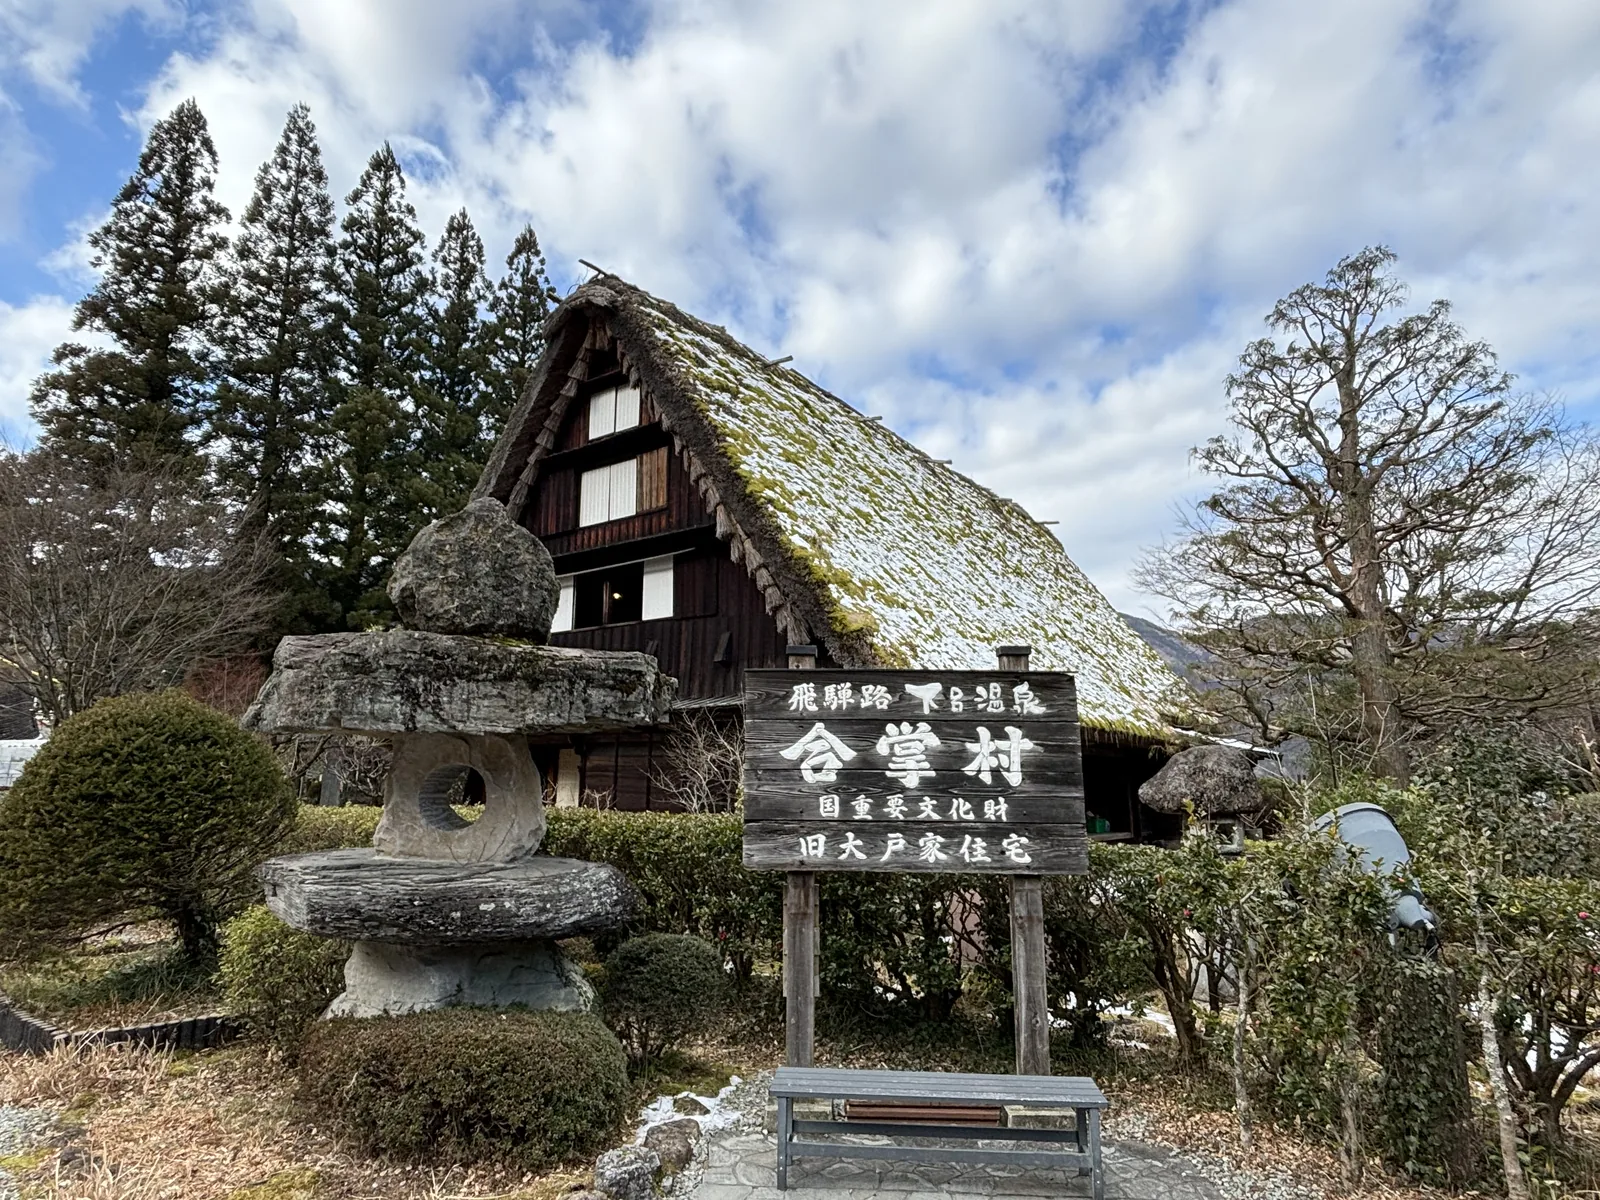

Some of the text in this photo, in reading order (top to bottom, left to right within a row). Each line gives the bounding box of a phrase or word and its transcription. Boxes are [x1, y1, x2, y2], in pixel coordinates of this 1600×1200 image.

[788, 681, 1047, 715] 飛騨路 下呂温泉
[779, 721, 1041, 789] 合掌村
[819, 794, 1009, 821] 国重要文化財
[800, 831, 1032, 864] 旧大戸家住宅
